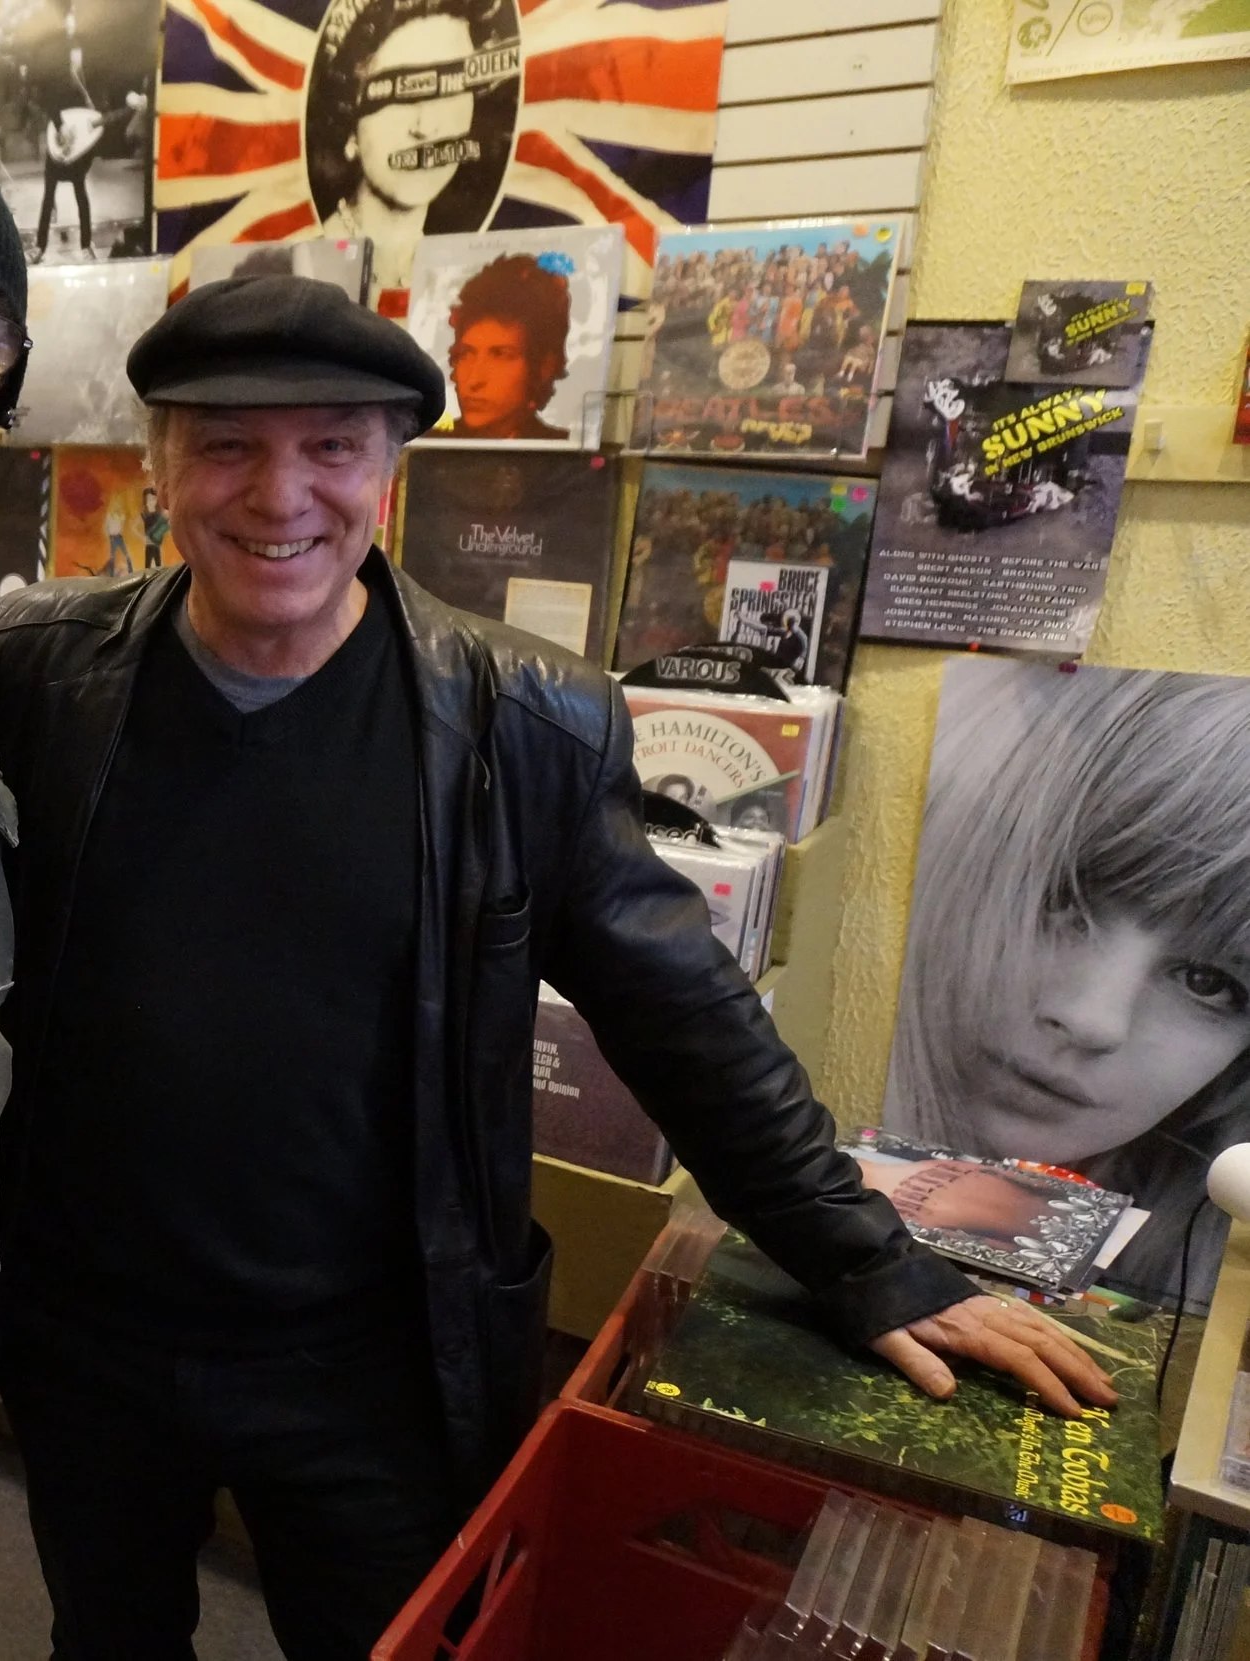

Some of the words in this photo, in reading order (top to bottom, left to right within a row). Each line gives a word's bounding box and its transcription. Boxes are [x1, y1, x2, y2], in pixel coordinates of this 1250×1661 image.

[465, 51, 520, 79] QUEEN
[1065, 298, 1131, 338] SUNNY
[981, 388, 1107, 461] SUNNY
[984, 463, 999, 477] IN
[1002, 446, 1033, 468] NEW
[1036, 406, 1124, 453] BRUNSWICK
[459, 533, 543, 556] Underground
[471, 523, 495, 543] The
[495, 525, 535, 545] Velvet
[918, 551, 945, 560] WITH
[777, 567, 821, 593] BRUCE
[730, 587, 818, 618] SPRINGSTEEN
[654, 656, 742, 684] VARIOUS
[651, 721, 767, 783] HAMILTON'S
[685, 740, 745, 790] DANCERS
[552, 1057, 561, 1069] &
[548, 1080, 580, 1099] Opinion
